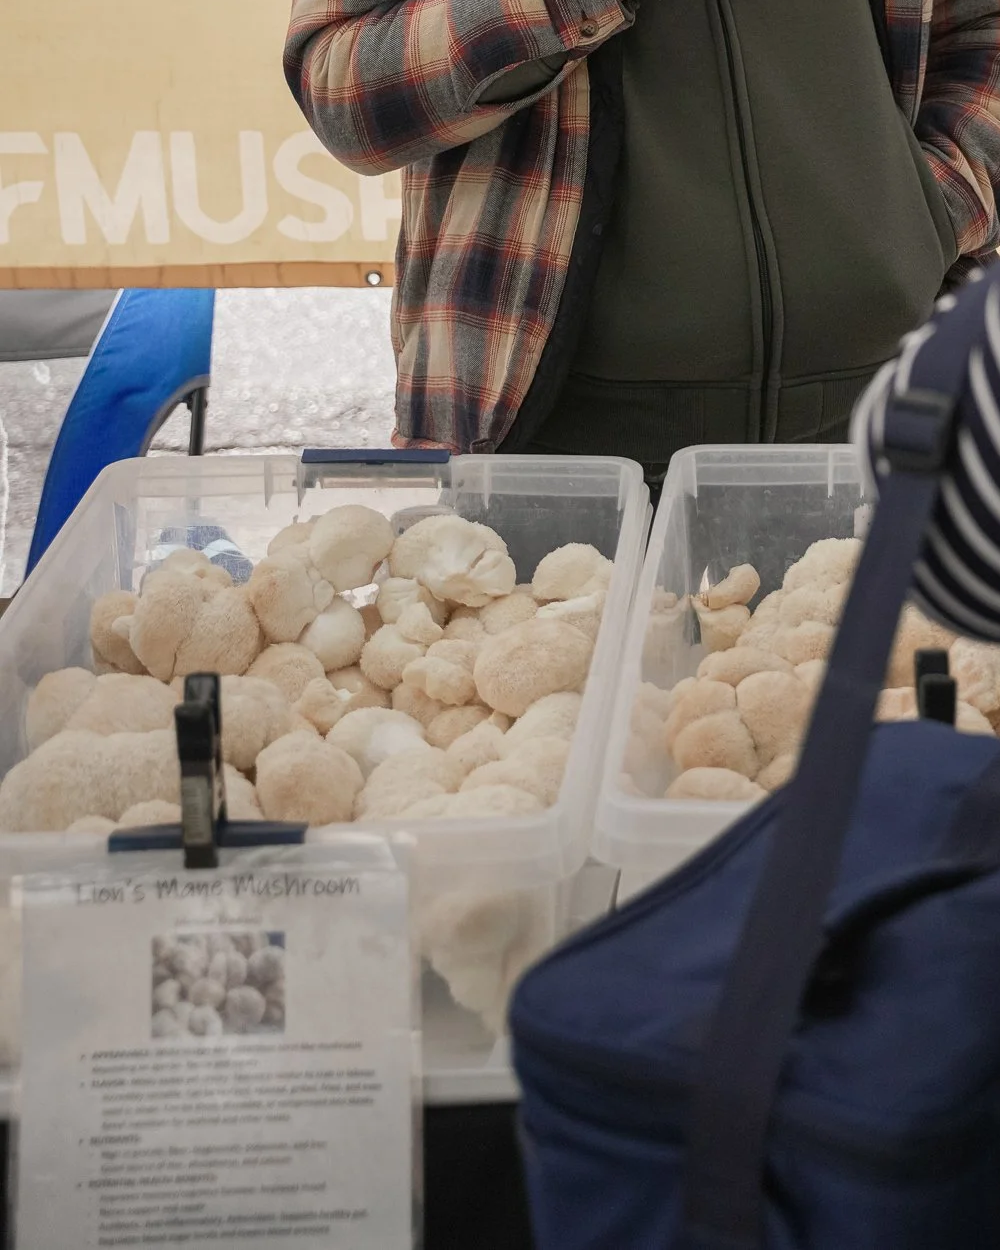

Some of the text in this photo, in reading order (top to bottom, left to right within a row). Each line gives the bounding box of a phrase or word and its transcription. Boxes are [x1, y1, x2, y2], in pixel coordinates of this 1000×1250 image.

[75, 872, 361, 906] Lion's Mane Mushroom
